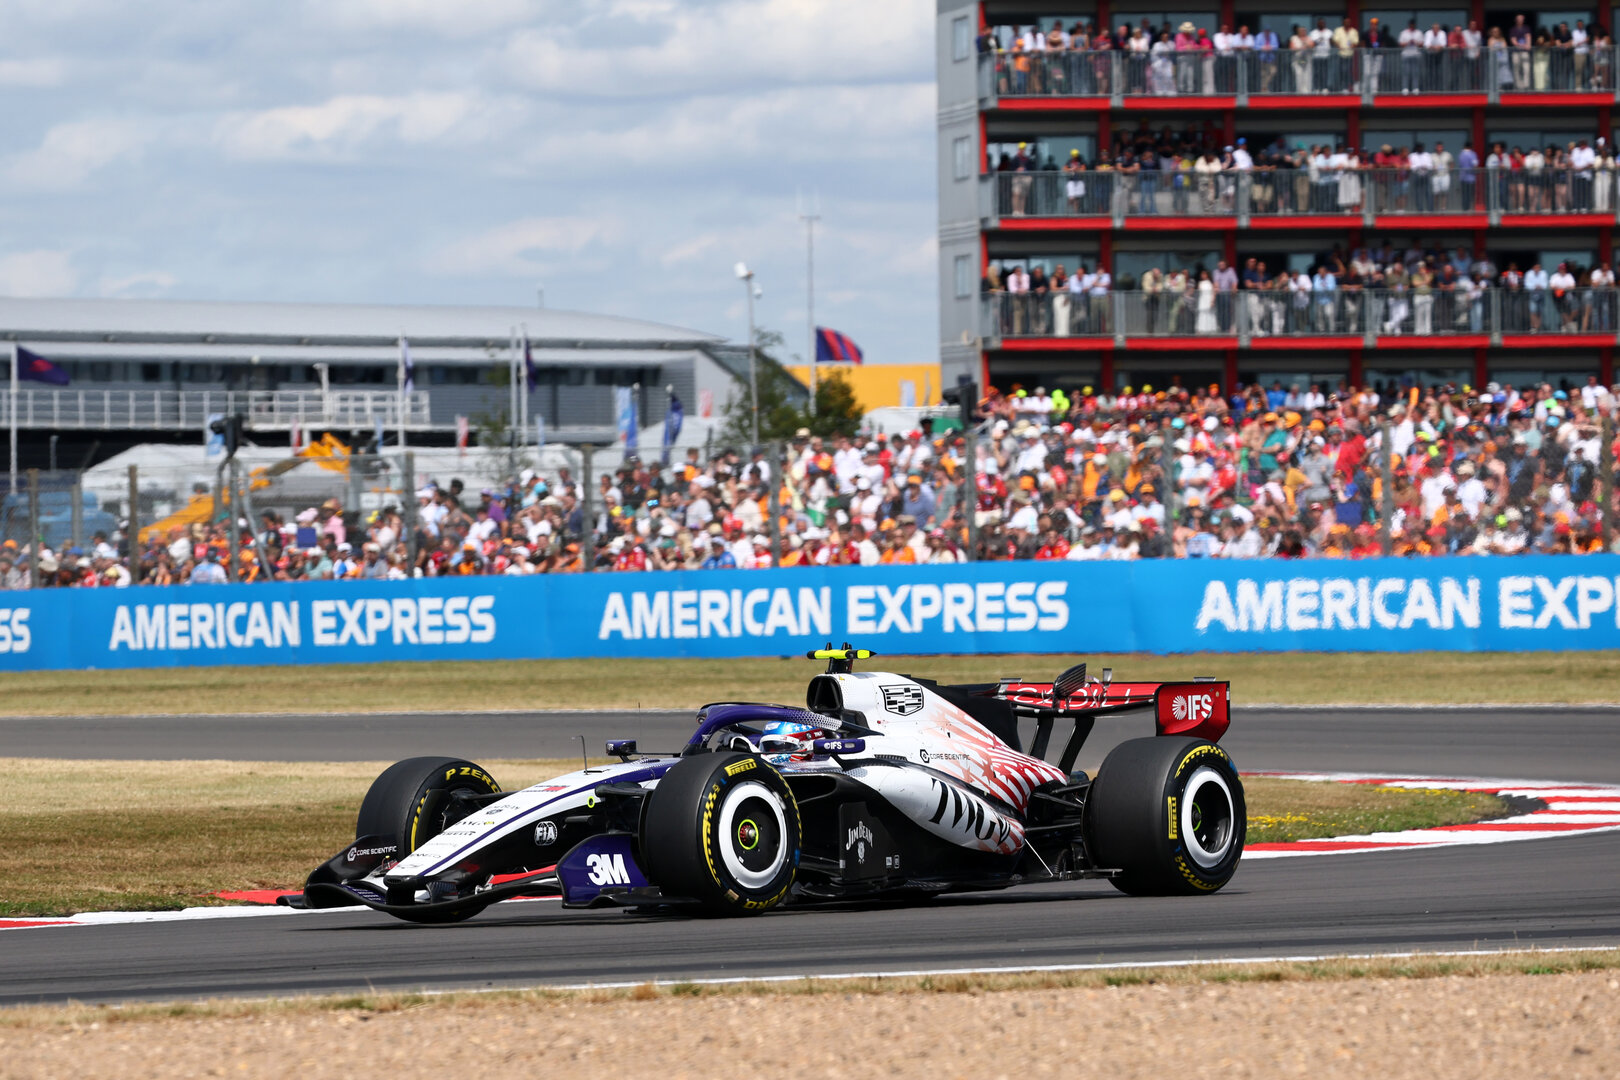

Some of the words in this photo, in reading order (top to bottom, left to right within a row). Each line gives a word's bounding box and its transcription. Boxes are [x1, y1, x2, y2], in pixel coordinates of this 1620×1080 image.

[599, 586, 831, 640] AMERICAN
[847, 581, 1069, 635] EXPRESS
[1194, 577, 1481, 633] AMERICAN
[1499, 575, 1620, 630] EXP
[109, 601, 301, 651] AMERICAN
[312, 595, 496, 647] EXPRESS
[1188, 694, 1212, 720] IFS
[830, 742, 842, 750] IFS
[445, 768, 456, 780] P
[724, 758, 757, 777] PIRELLI
[1167, 795, 1178, 840] PIRELLI
[586, 853, 631, 886] 3M
